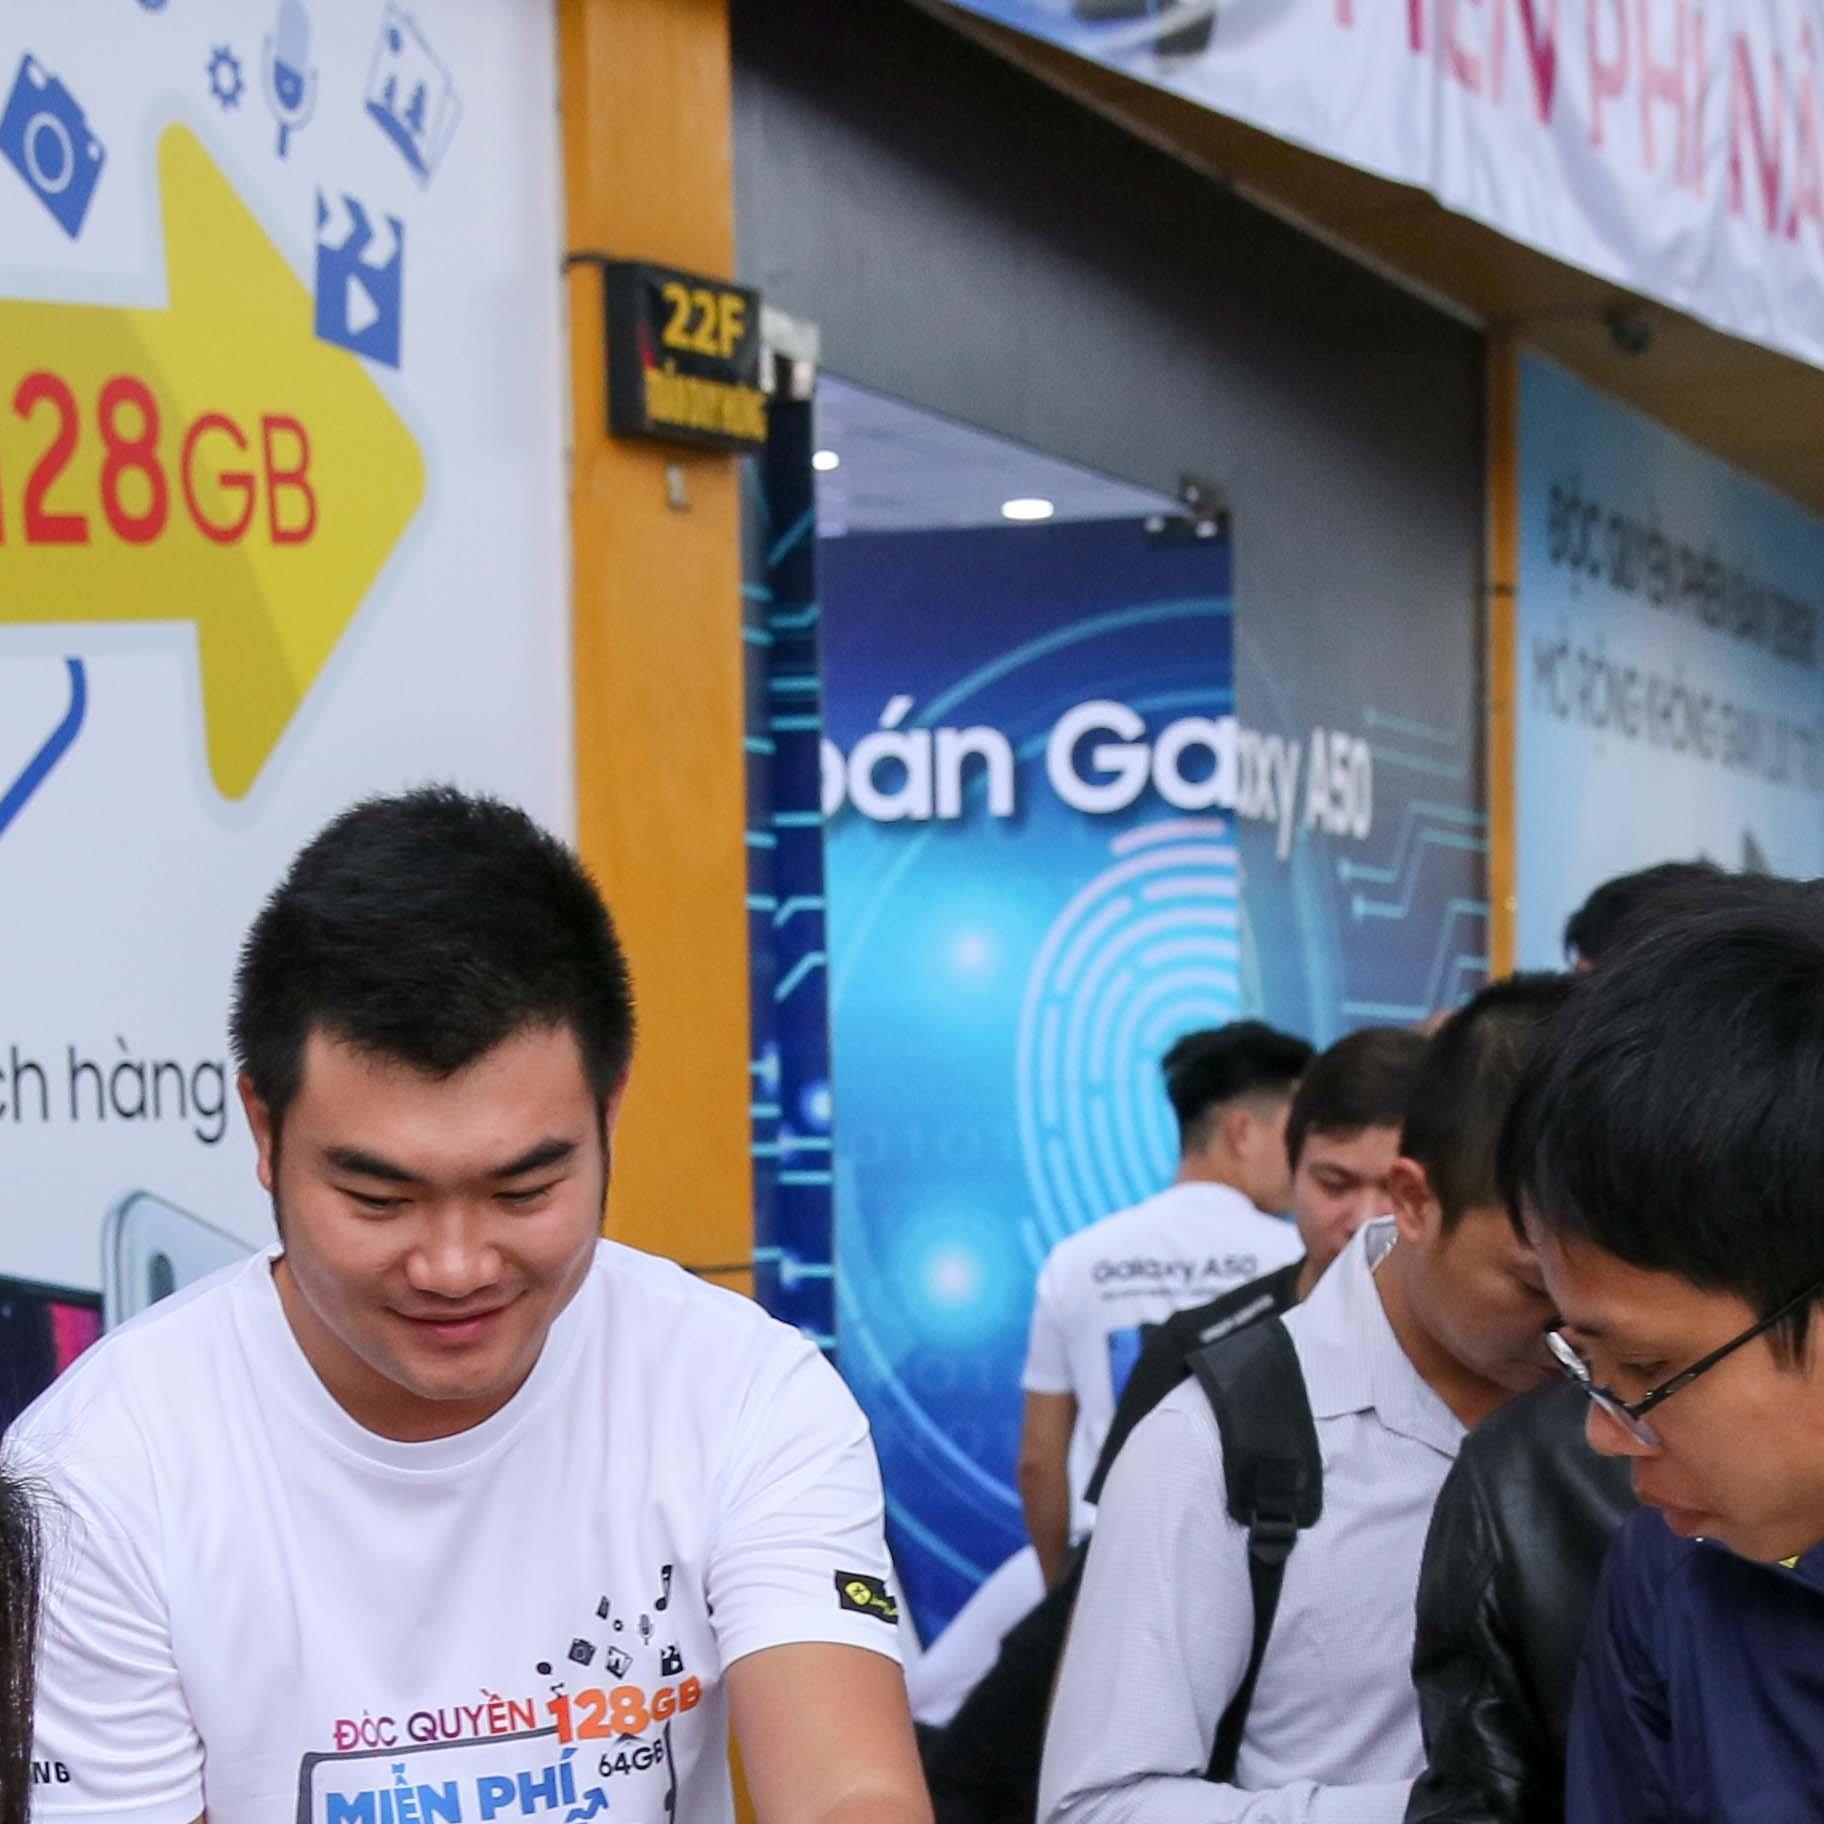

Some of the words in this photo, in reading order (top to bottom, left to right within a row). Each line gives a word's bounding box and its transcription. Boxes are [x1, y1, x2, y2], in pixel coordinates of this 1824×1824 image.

[661, 281, 746, 359] 22F
[1306, 724, 1373, 840] A50
[68, 1035, 230, 1144] hàng
[1092, 1257, 1196, 1285] Galaxy
[1204, 1253, 1258, 1278] A50
[407, 1688, 537, 1743] QUYỀN
[546, 1675, 702, 1745] 128GB
[479, 1747, 578, 1823] PHÍ
[598, 1738, 665, 1778] 64GB
